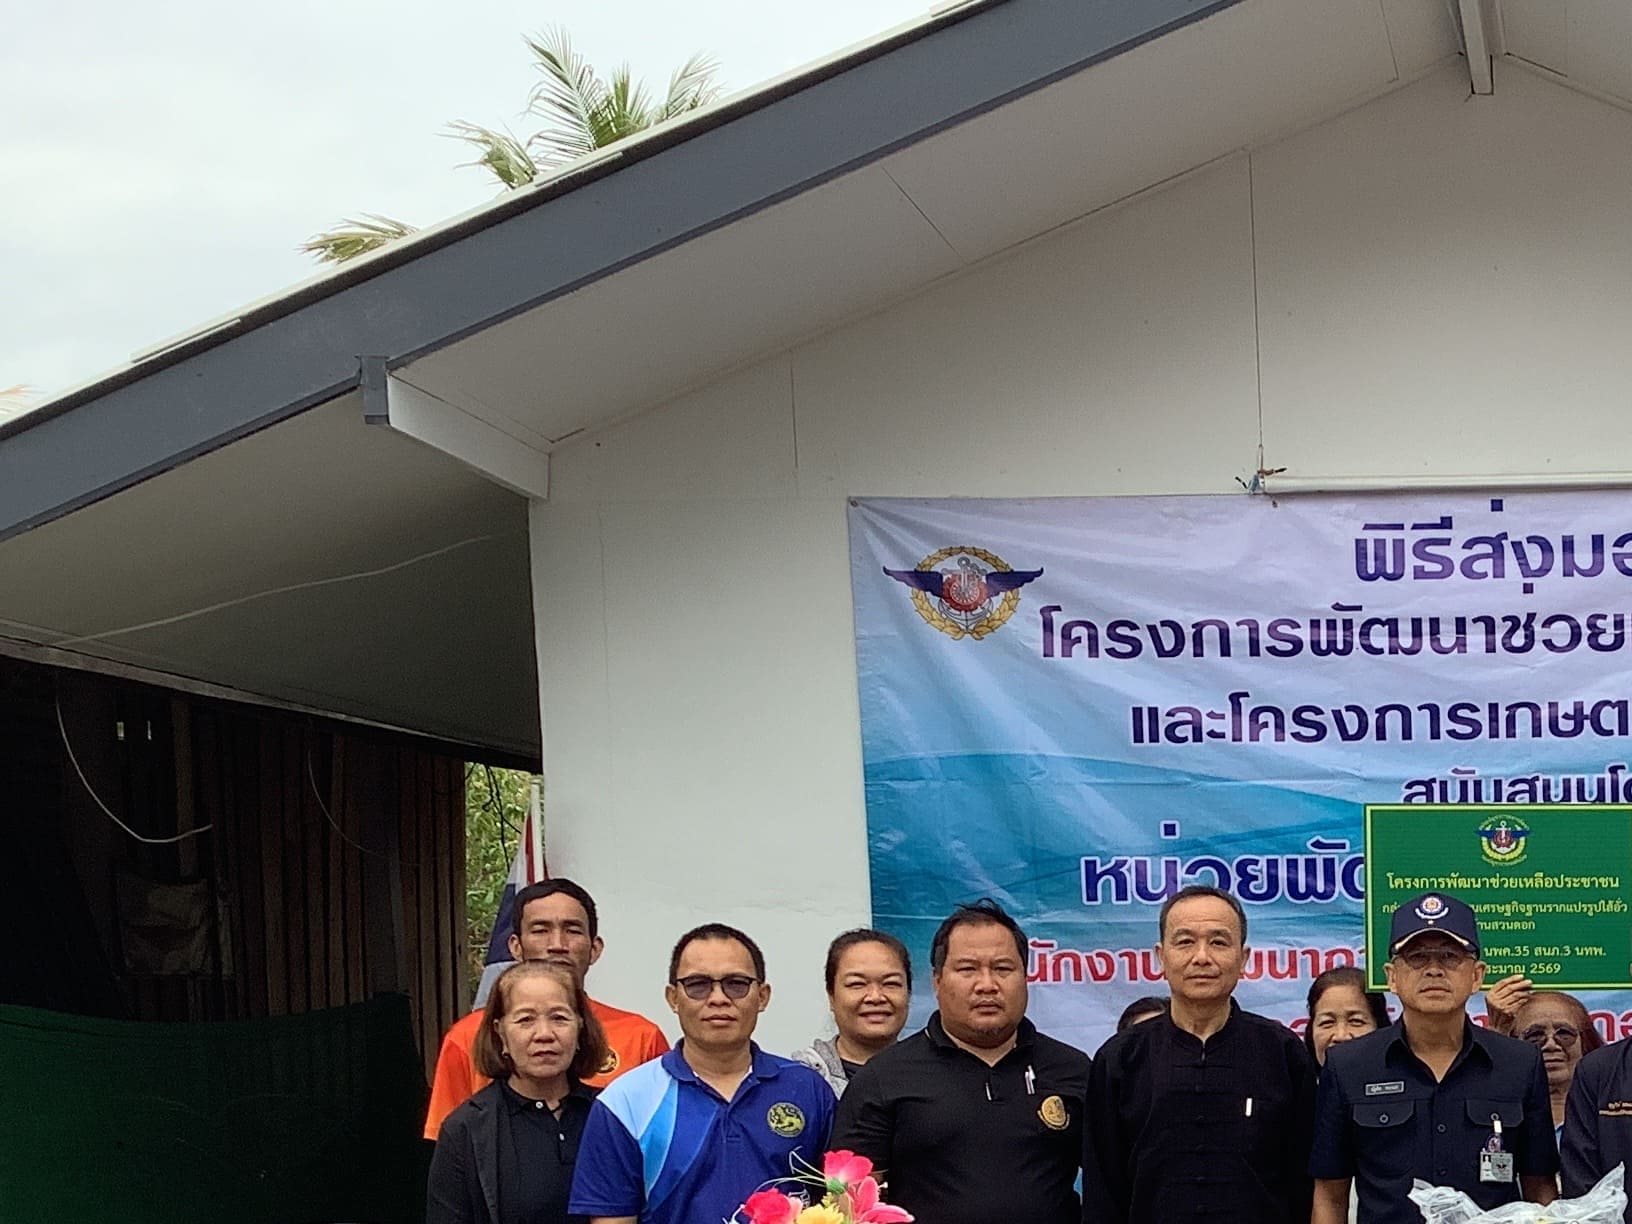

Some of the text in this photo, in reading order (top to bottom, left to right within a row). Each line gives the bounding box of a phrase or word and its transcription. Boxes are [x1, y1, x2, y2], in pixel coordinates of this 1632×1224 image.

[1386, 872, 1620, 890] โครงการพัฒนาช่วยเหลือประชาชน
[1484, 945, 1607, 957] นพค.35 สนภ.3 นทพ.
[1486, 963, 1561, 975] ระมาณ 2569
